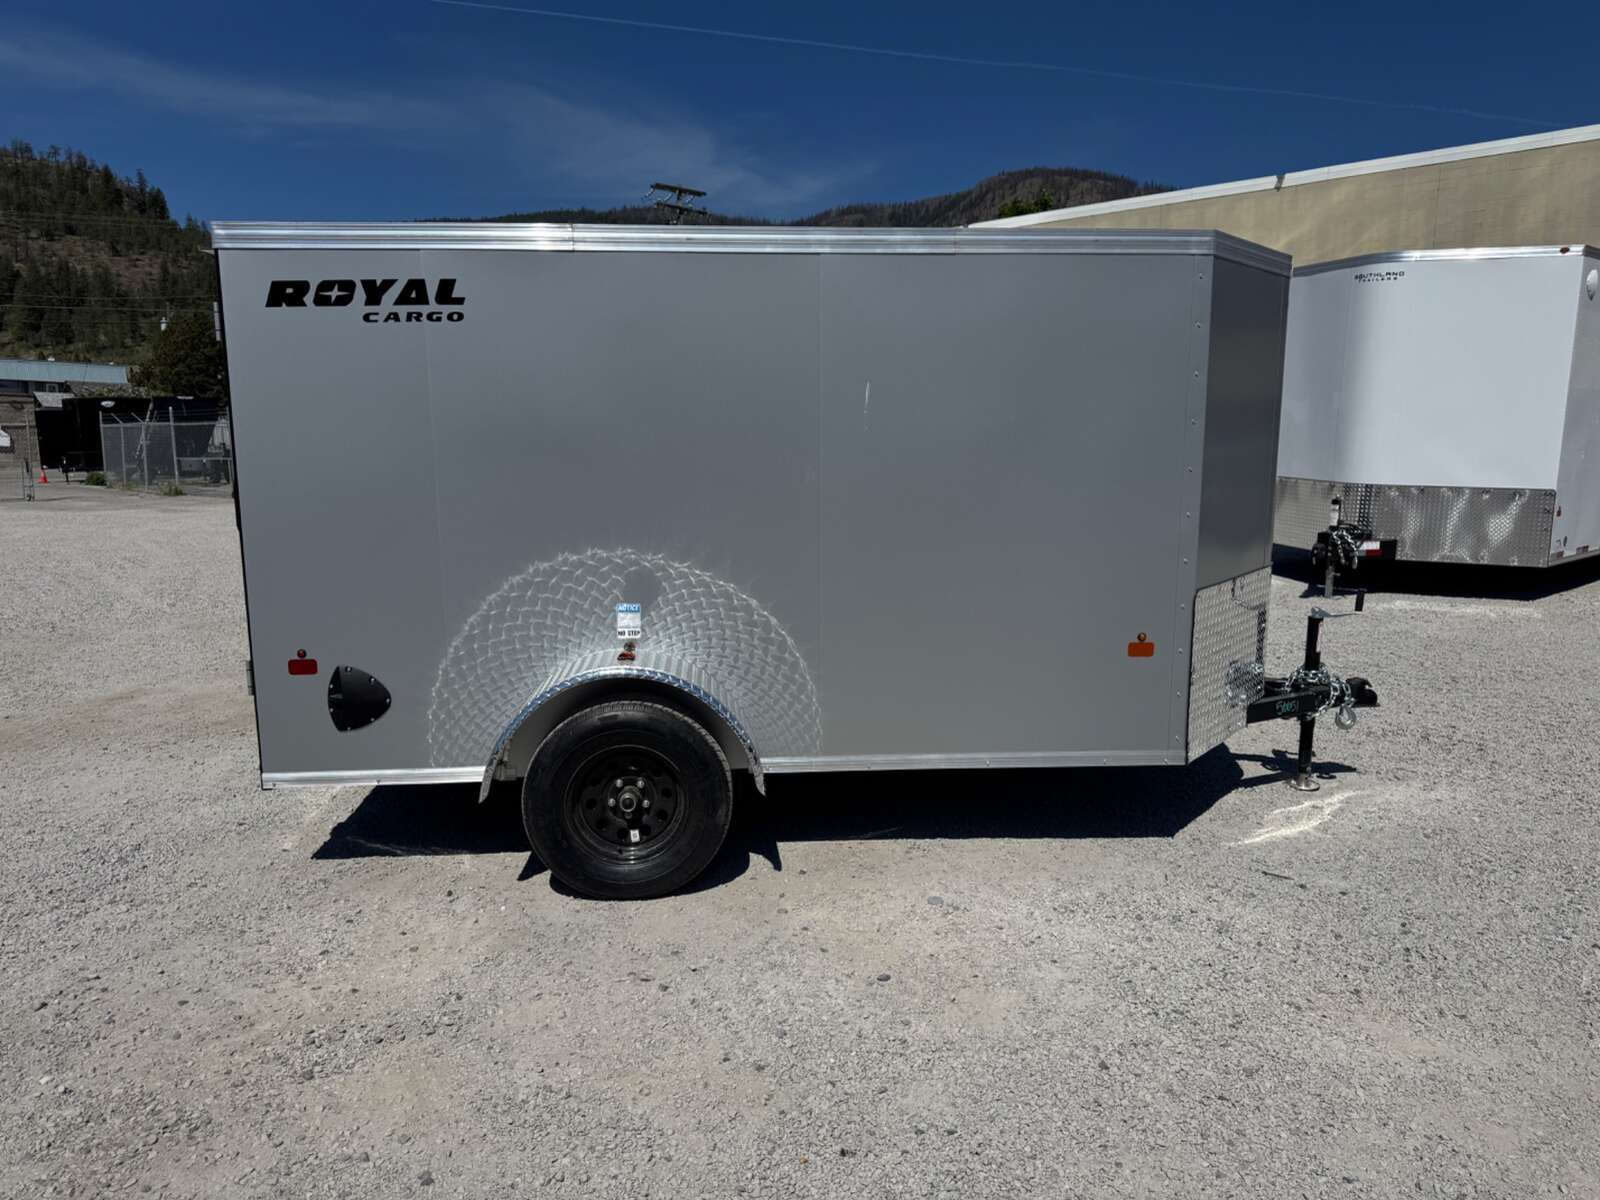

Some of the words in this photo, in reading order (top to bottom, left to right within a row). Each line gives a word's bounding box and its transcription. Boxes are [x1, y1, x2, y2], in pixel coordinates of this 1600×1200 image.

[265, 278, 466, 308] ROYAL
[362, 311, 465, 323] CARGO
[617, 603, 640, 611] NOTICE
